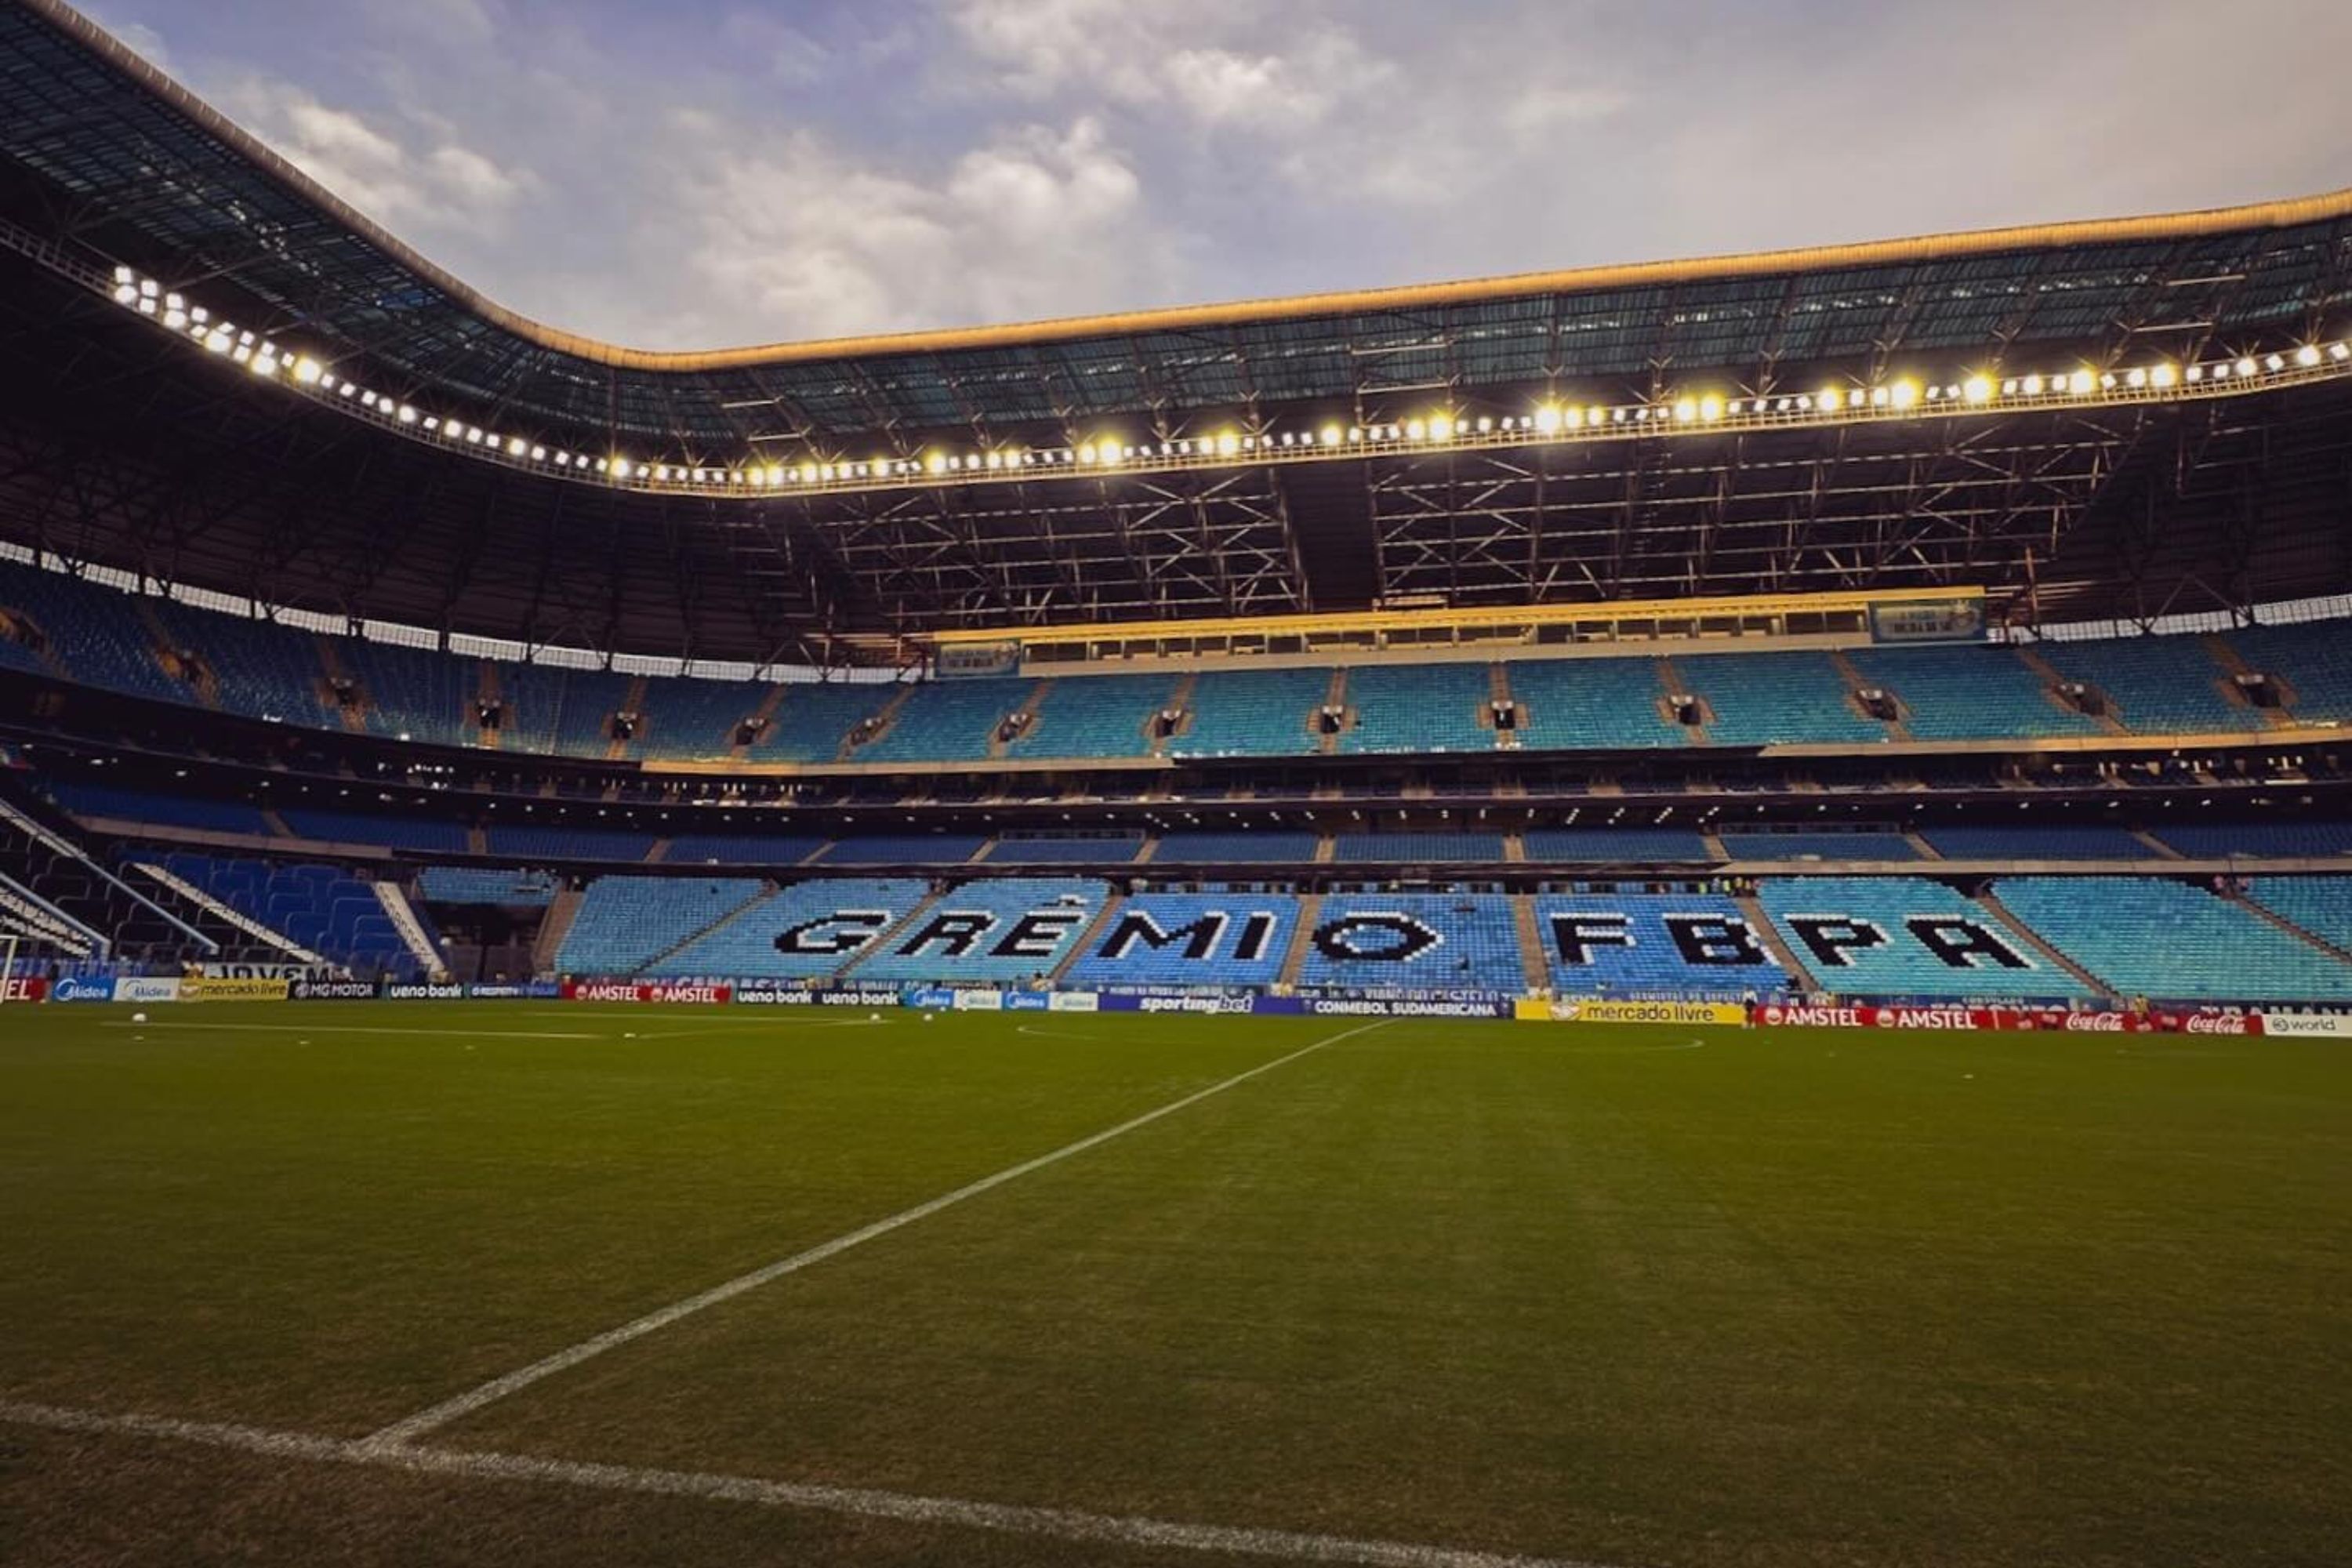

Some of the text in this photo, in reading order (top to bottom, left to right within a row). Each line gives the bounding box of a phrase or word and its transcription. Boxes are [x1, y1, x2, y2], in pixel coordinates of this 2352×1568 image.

[774, 895, 2034, 968] GRÊMIO FBPA
[64, 984, 108, 1000] Midea
[310, 983, 330, 996] MG
[332, 983, 373, 996] MOTOR
[391, 985, 424, 997] ueno
[428, 983, 463, 998] bank
[589, 986, 641, 1001] AMSTEL
[666, 986, 718, 1003] AMSTEL
[738, 989, 812, 1004] ueno bank
[823, 991, 898, 1005] ueno bank
[1140, 994, 1254, 1013] sportingbet
[1314, 1000, 1497, 1017] CONMEBOL SUDAMERICANA
[1587, 1005, 1715, 1022] mercado livre
[1785, 1009, 1863, 1026] AMSTEL
[1898, 1011, 1978, 1029] AMSTEL
[2288, 1018, 2336, 1032] world
